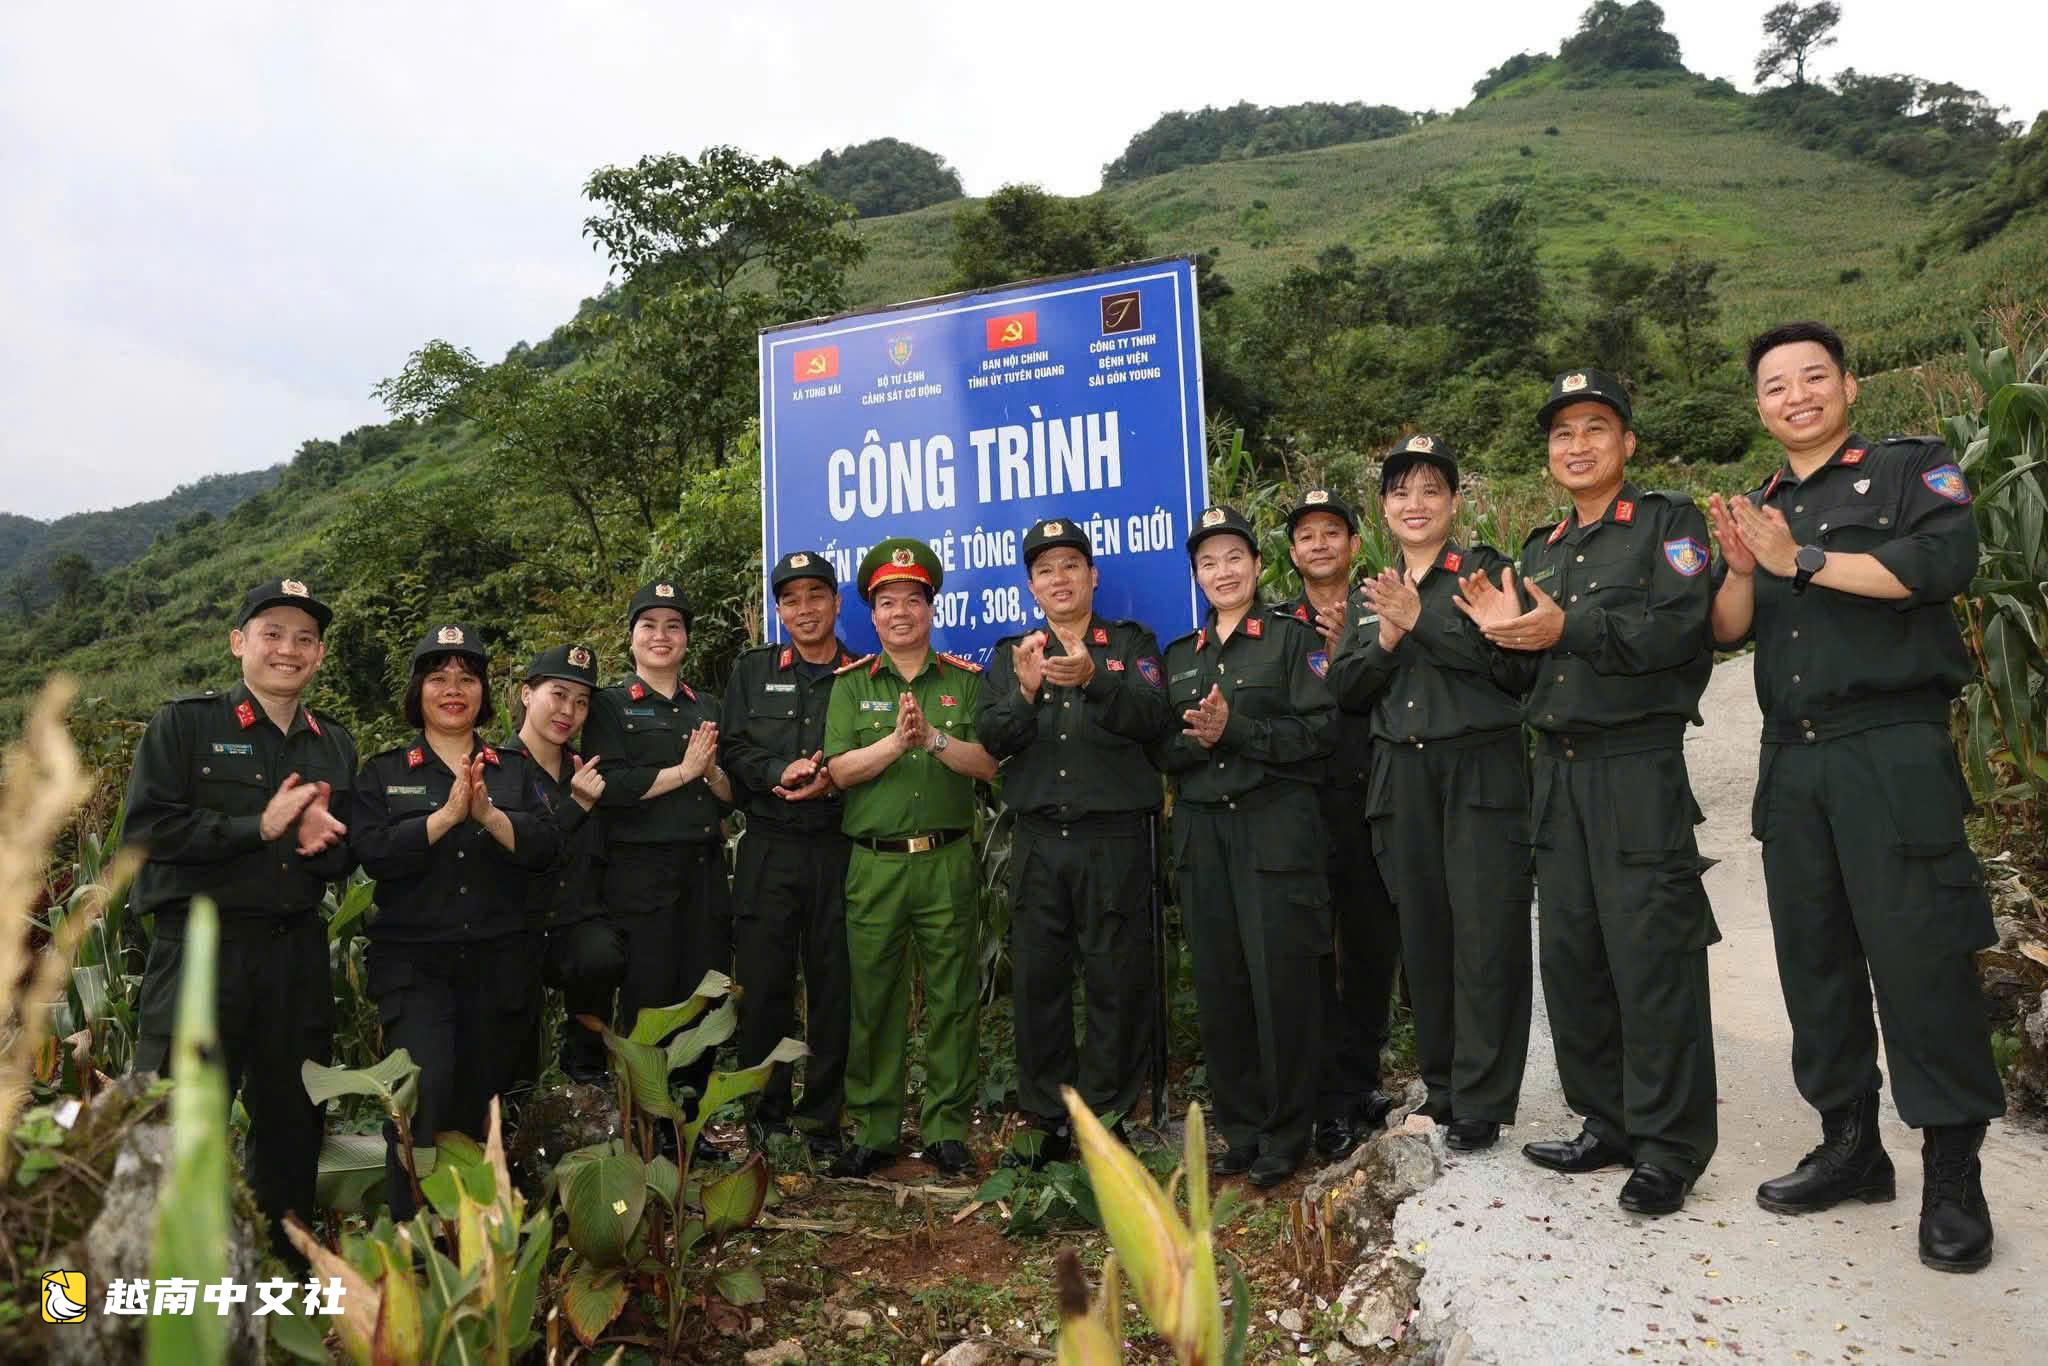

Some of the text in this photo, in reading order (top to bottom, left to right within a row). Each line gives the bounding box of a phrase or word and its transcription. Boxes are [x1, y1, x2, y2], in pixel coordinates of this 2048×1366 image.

[1089, 334, 1157, 353] CÔNG TY TNHH
[982, 350, 1049, 370] BAN NỘI CHÍNH
[1098, 351, 1149, 370] BỆNH VIỆN
[1004, 369, 1032, 384] TUYÊN
[1034, 364, 1065, 380] QUANG
[1088, 373, 1105, 387] SÀI
[1129, 367, 1161, 381] YOUNG
[828, 405, 1121, 521] CÔNG TRÌNH
[961, 526, 1016, 570] TÔNG
[1127, 505, 1174, 554] GIỚI
[933, 586, 1027, 630] 307, 308,
